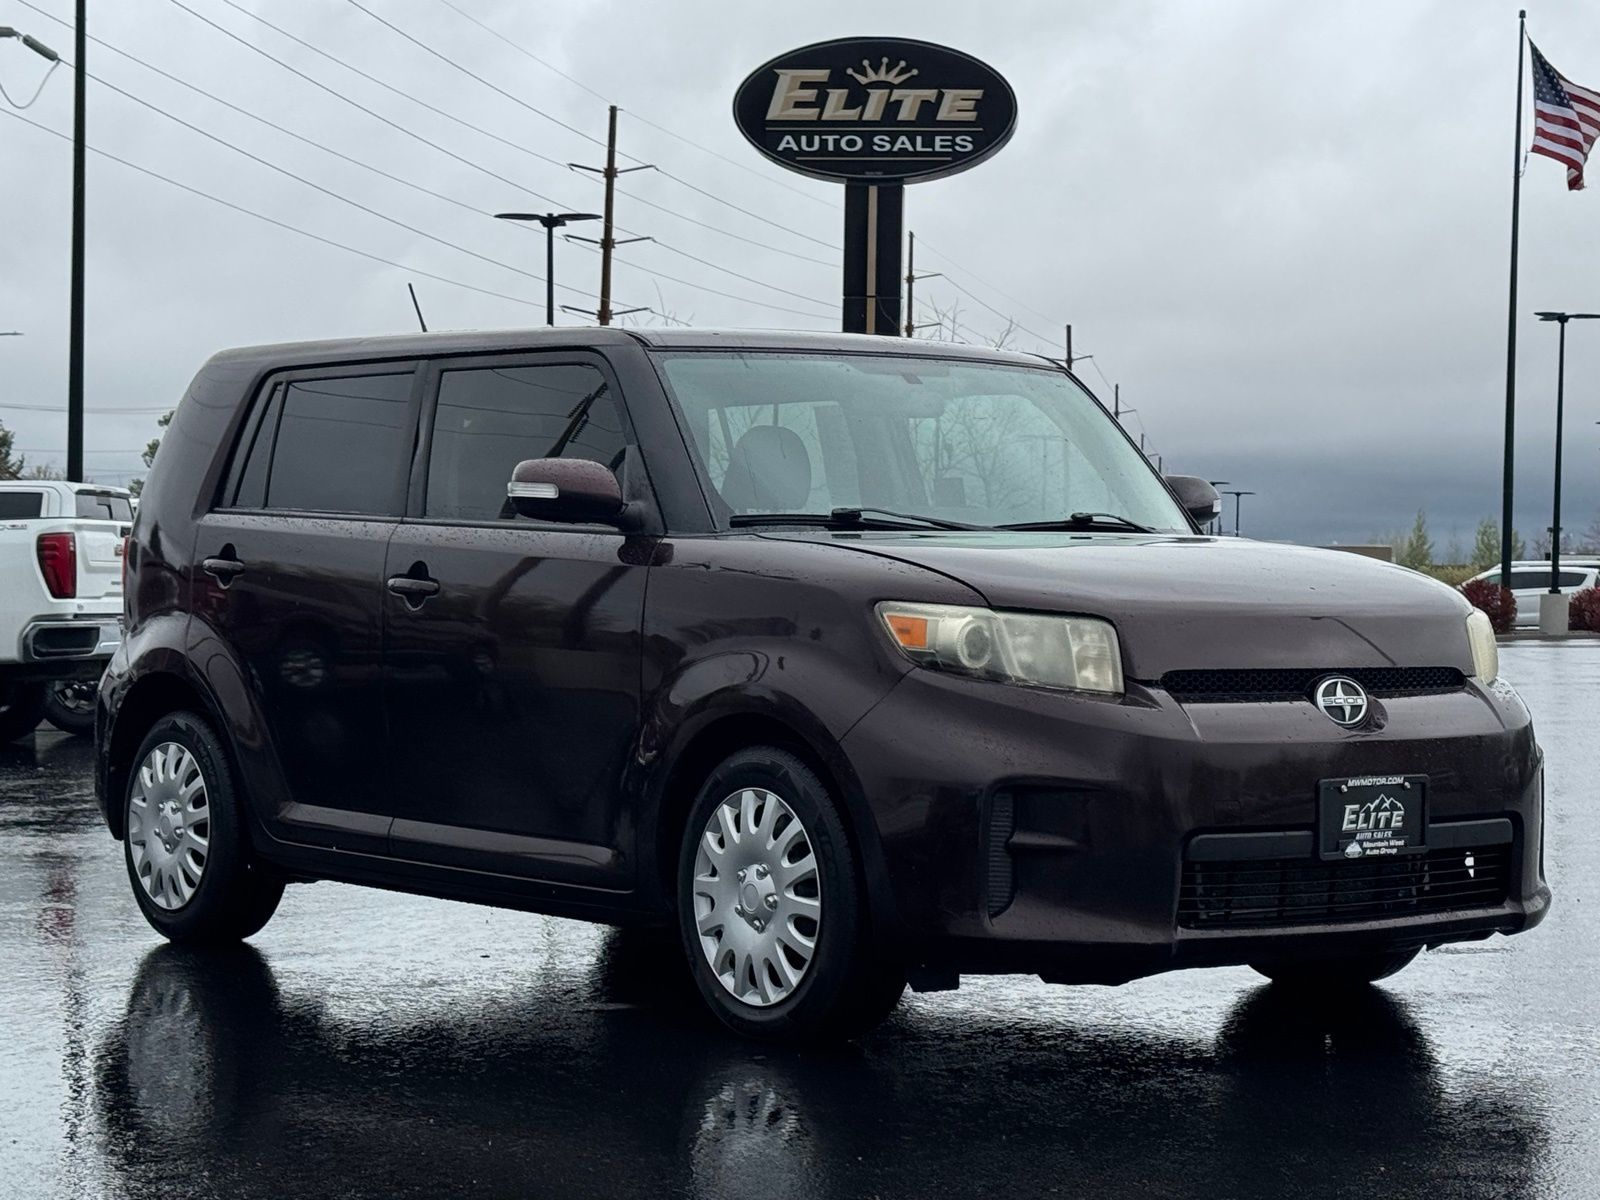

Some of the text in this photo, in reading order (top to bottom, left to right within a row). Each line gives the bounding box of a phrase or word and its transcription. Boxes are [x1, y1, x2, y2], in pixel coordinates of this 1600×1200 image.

[765, 69, 985, 122] ELITE
[777, 135, 974, 152] AUTO SALES
[1347, 776, 1404, 786] MWMOTOR.COM
[1342, 804, 1404, 830] ELITE
